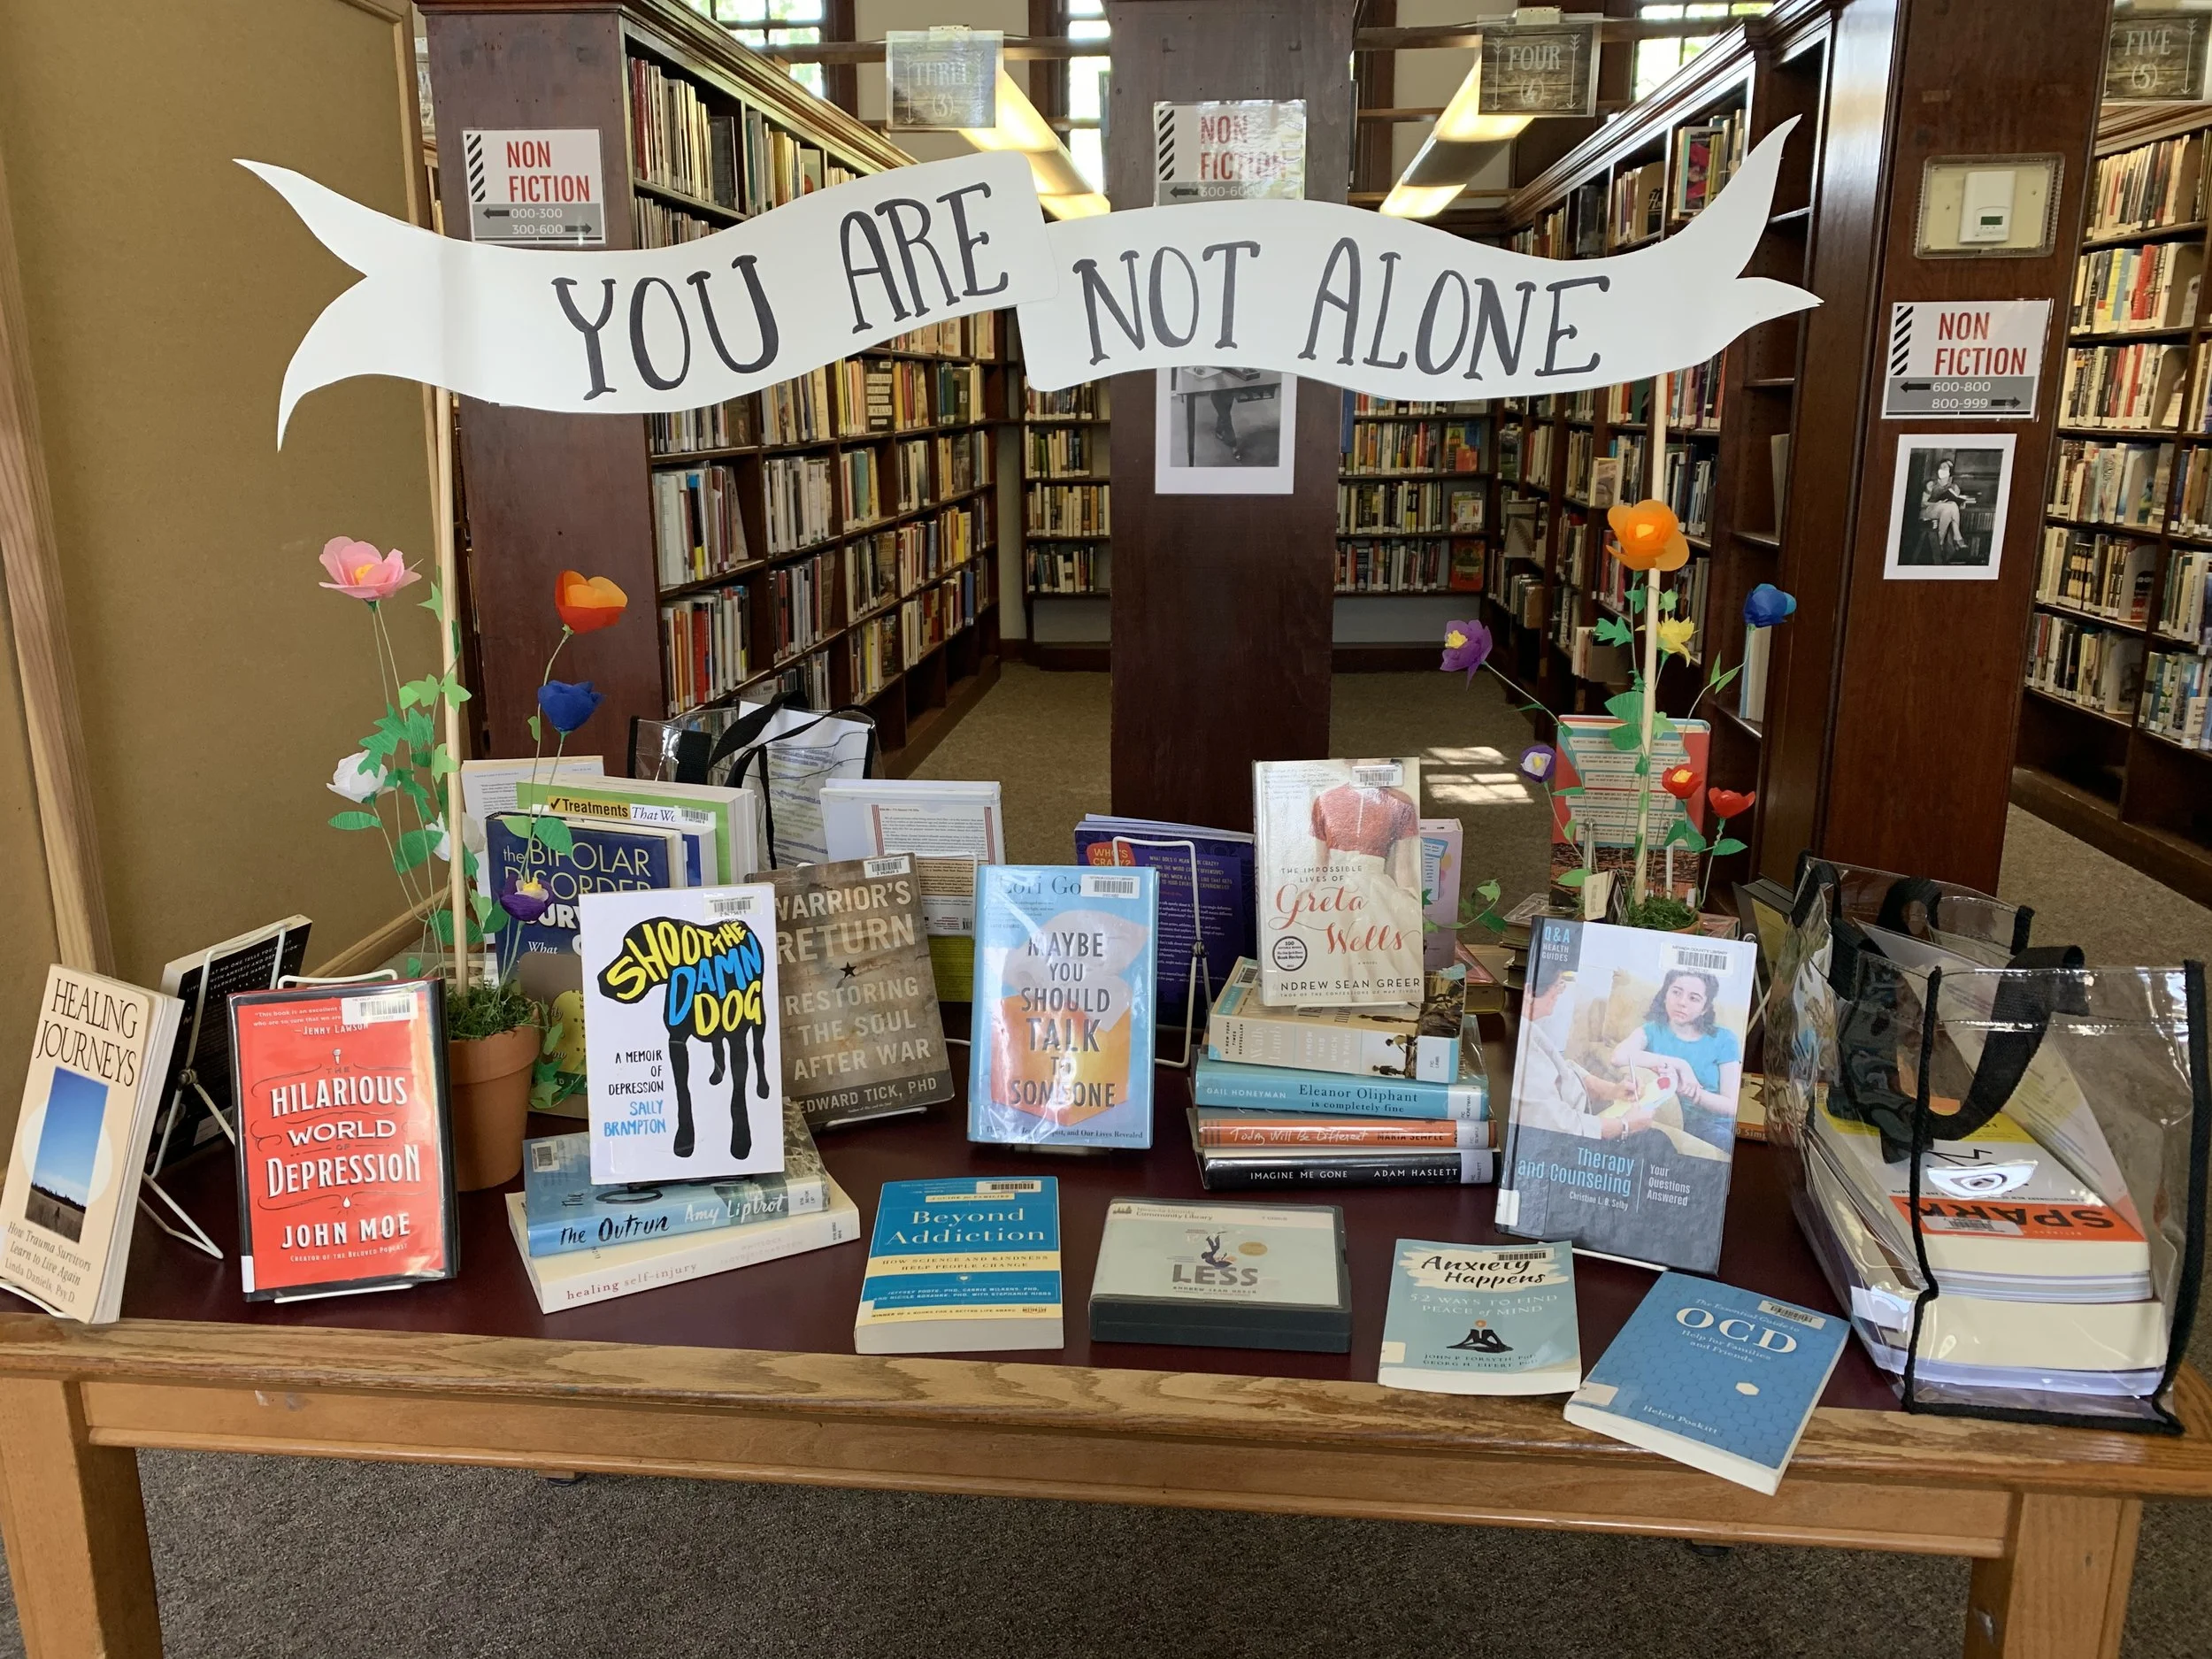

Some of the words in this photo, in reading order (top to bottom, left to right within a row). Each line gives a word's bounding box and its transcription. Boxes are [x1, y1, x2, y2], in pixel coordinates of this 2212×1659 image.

[2124, 29, 2173, 56] FIVE
[1508, 45, 1561, 71] FOUR
[2131, 63, 2158, 89] (5)
[1201, 116, 1248, 144] NON
[506, 141, 551, 168] NON
[509, 175, 590, 203] FICTION
[511, 208, 563, 219] 000-300
[512, 224, 564, 234] 300-600
[551, 254, 780, 401] YOU
[839, 181, 1009, 334] ARE
[1072, 241, 1261, 365] NOT
[1297, 237, 1610, 380] ALONE
[1939, 311, 1990, 341] NON
[1934, 347, 2027, 376] FICTION
[1932, 381, 1991, 393] 600-800
[1932, 398, 1988, 409] 800-999
[562, 798, 628, 818] Treatments
[631, 806, 658, 821] That
[503, 845, 526, 864] the
[531, 838, 651, 877] BIPOLAR
[1092, 858, 1132, 867] CRAY?
[1303, 864, 1363, 874] IMPOSSIBLE
[775, 880, 912, 922] WARRIOR'S
[1269, 883, 1369, 931] Greta
[528, 941, 558, 955] What
[777, 913, 917, 965] RETURN
[1027, 932, 1104, 957] MAYBE
[1326, 921, 1417, 955] Wells
[1542, 942, 1570, 954] HEALTH
[1543, 926, 1571, 944] Q&A
[607, 921, 713, 1001] SHOOT
[711, 921, 747, 955] THE
[1541, 951, 1570, 963] GUIDES
[669, 932, 762, 1026] DAMN
[1049, 962, 1084, 982] YOU
[1280, 980, 1328, 991] NDREW
[1335, 979, 1370, 988] SEAN
[1377, 978, 1420, 987] GREER
[51, 978, 138, 1040] HEALING
[695, 980, 762, 1036] DOG
[785, 976, 919, 1017] RESTORING
[1021, 987, 1110, 1013] SHOULD
[797, 1019, 846, 1047] THE
[855, 1009, 917, 1037] SOUL
[1026, 1018, 1101, 1052] TALK
[35, 1019, 137, 1087] JOURNEYS
[616, 1053, 622, 1064] A
[626, 1049, 663, 1064] MEMOIR
[794, 1048, 868, 1081] AFTER
[876, 1038, 931, 1066] WAR
[651, 1065, 663, 1077] OF
[271, 1075, 409, 1118] HILARIOUS
[608, 1080, 664, 1095] DEPRESSION
[799, 1091, 859, 1115] EDWARD
[864, 1085, 903, 1102] TICK,
[908, 1077, 938, 1095] PHD
[1232, 1089, 1286, 1099] HONEYMAN
[1299, 1085, 1352, 1098] Eleanor
[1356, 1087, 1418, 1103] Oliphant
[630, 1100, 664, 1116] SALLY
[1322, 1102, 1380, 1114] completely
[1384, 1103, 1404, 1113] fine
[287, 1119, 397, 1147] WORLD
[603, 1118, 666, 1137] BRAMPTON
[1230, 1127, 1265, 1146] Today
[1271, 1128, 1292, 1142] Will
[1296, 1128, 1310, 1141] Be
[1316, 1129, 1370, 1142] Different
[1377, 1133, 1406, 1141] MARIA
[1408, 1133, 1445, 1141] SEMPLE
[266, 1144, 421, 1199] DEPRESSION
[1250, 1171, 1294, 1179] IMAGINE
[1300, 1170, 1315, 1179] ME
[1319, 1170, 1348, 1179] GONE
[1373, 1168, 1406, 1178] ADAM
[1411, 1167, 1458, 1178] HASLETT
[1577, 1147, 1635, 1177] Therapy
[1649, 1164, 1671, 1178] Your
[1518, 1159, 1545, 1179] and
[1549, 1163, 1632, 1198] Counseling
[1648, 1178, 1691, 1194] Questions
[1647, 1189, 1688, 1207] Answered
[559, 1226, 587, 1247] The
[598, 1214, 671, 1243] Outrun
[685, 1204, 719, 1225] Amy
[726, 1193, 788, 1224] Liptrot
[913, 1208, 1025, 1227] Beyond
[1136, 1210, 1183, 1220] Community
[1184, 1213, 1214, 1222] Library
[281, 1222, 348, 1249] JOHN
[359, 1212, 411, 1243] MOE
[885, 1227, 1046, 1246] Addiction
[7, 1221, 25, 1239] How
[27, 1229, 56, 1254] Trauma
[58, 1243, 92, 1272] Survivors
[4, 1257, 25, 1277] Linda
[26, 1266, 54, 1294] Daniels,
[10, 1240, 31, 1262] Learn
[33, 1254, 41, 1265] to
[42, 1256, 58, 1274] Live
[58, 1264, 81, 1286] Again
[1172, 1264, 1259, 1286] LESS
[1421, 1256, 1531, 1275] Anxiety
[566, 1279, 619, 1302] healing
[623, 1262, 699, 1289] self-injury
[1443, 1272, 1547, 1289] Happens
[1410, 1294, 1432, 1302] 52
[1439, 1296, 1480, 1306] WAYS
[1517, 1294, 1557, 1303] FIND
[1422, 1304, 1473, 1315] PEACE
[1479, 1309, 1493, 1317] of
[1497, 1305, 1543, 1316] MIND
[1695, 1297, 1713, 1307] The
[1714, 1302, 1758, 1319] Essential
[1759, 1313, 1786, 1328] Guide
[1676, 1308, 1798, 1353] OCD
[1681, 1328, 1707, 1342] Help
[1708, 1337, 1724, 1346] for
[1726, 1341, 1772, 1361] Families
[1689, 1340, 1710, 1350] and
[1712, 1343, 1755, 1363] Friends
[1643, 1404, 1676, 1420] Helen
[1680, 1415, 1719, 1435] Poskitt
